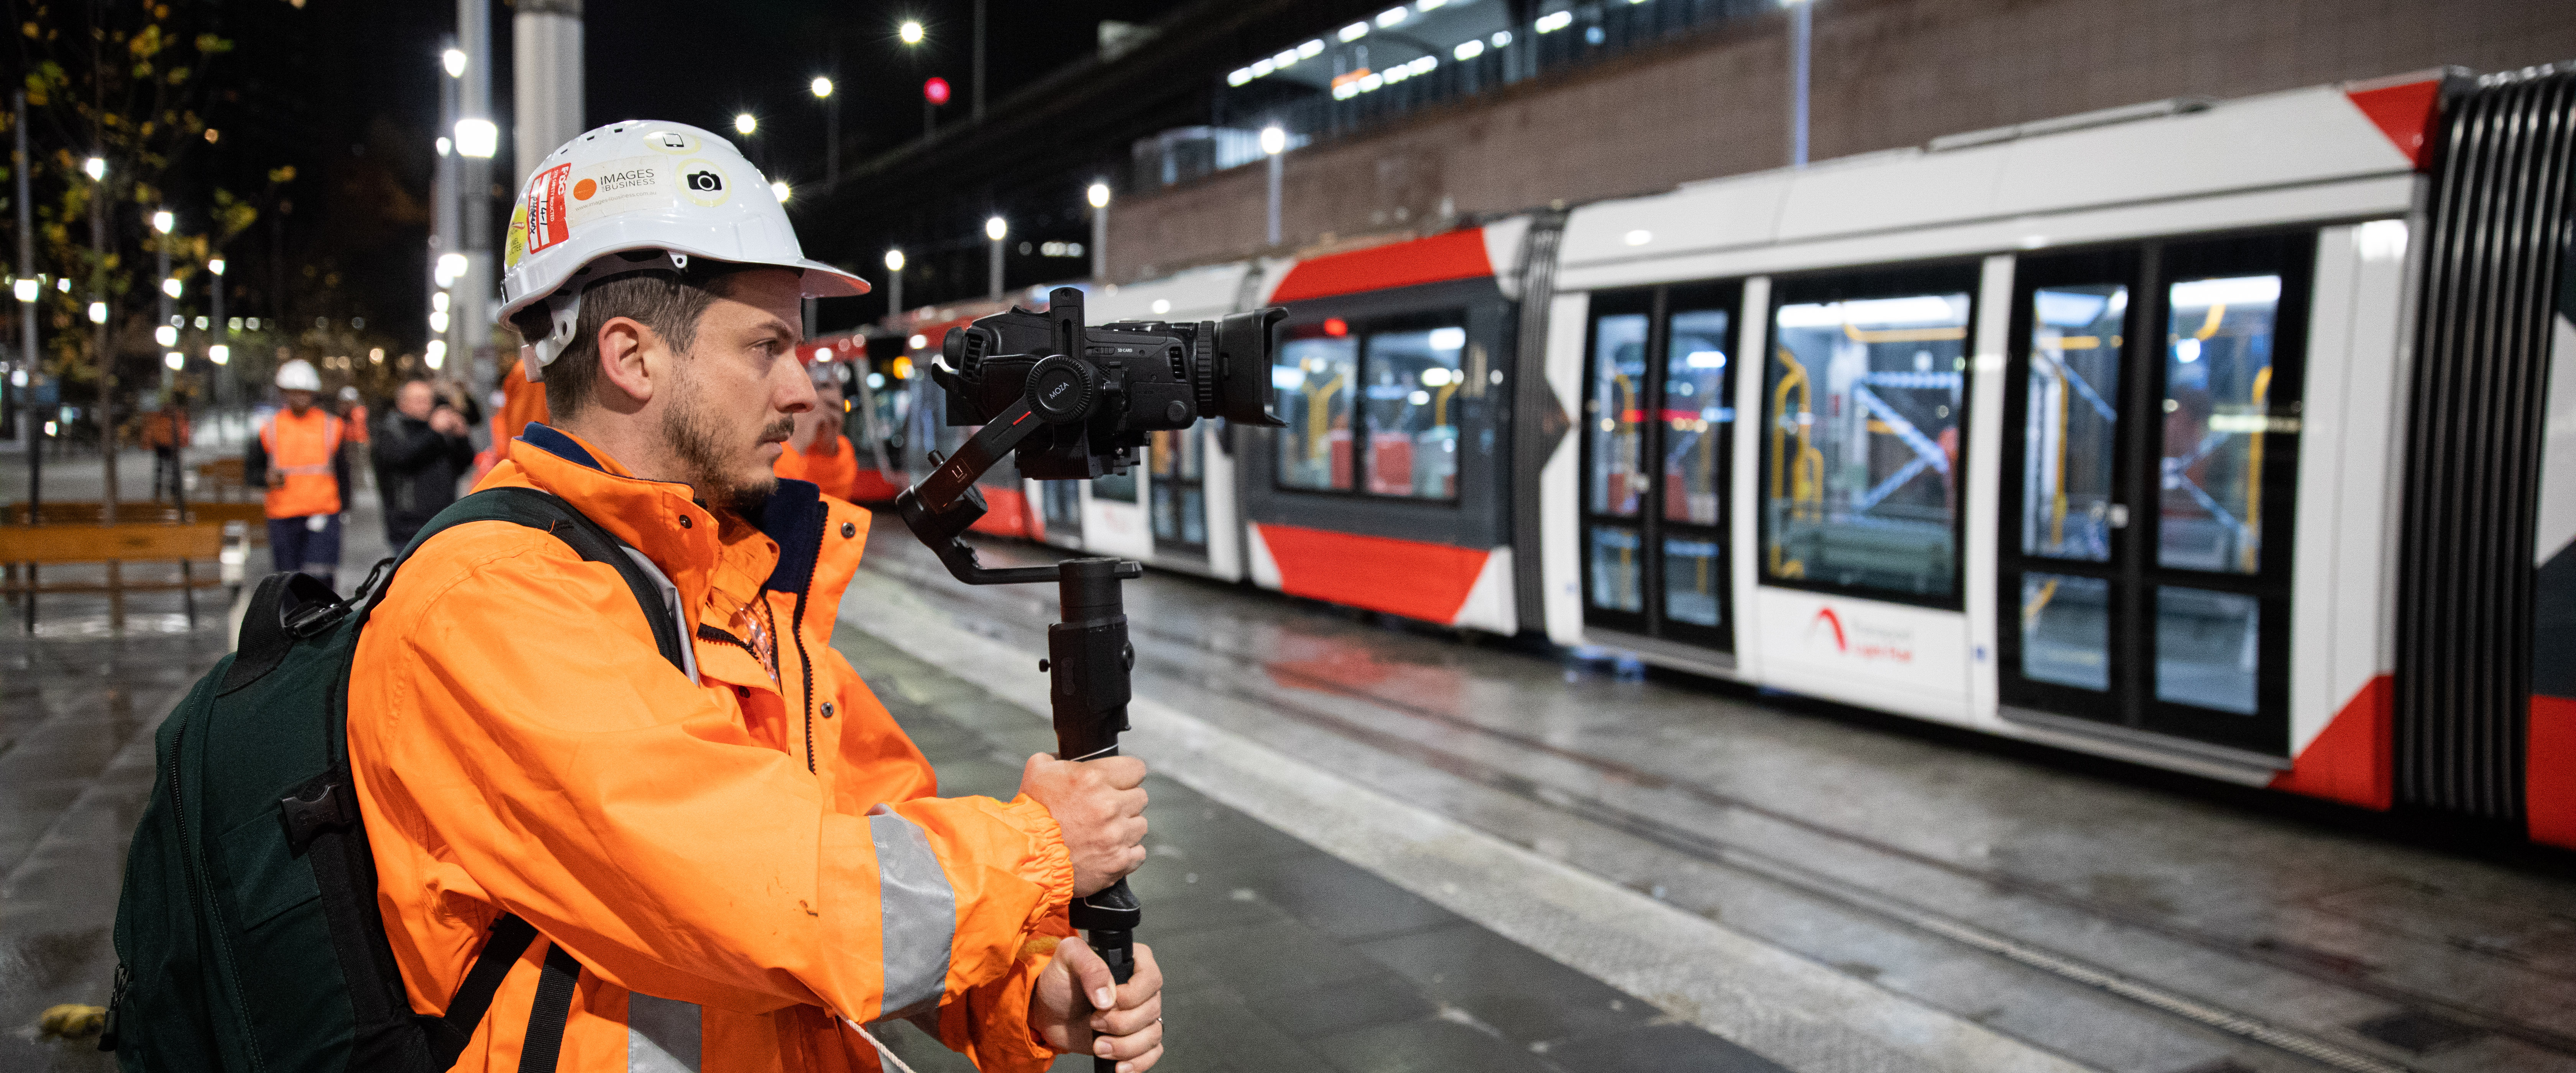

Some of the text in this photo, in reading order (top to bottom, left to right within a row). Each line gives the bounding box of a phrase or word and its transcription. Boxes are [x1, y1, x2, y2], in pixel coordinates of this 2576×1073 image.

[558, 166, 569, 195] FDC
[601, 169, 654, 185] IMAGES
[605, 178, 655, 192] BUSINESS
[575, 191, 657, 211] www.images4business.com.au
[1049, 382, 1069, 399] MOZA
